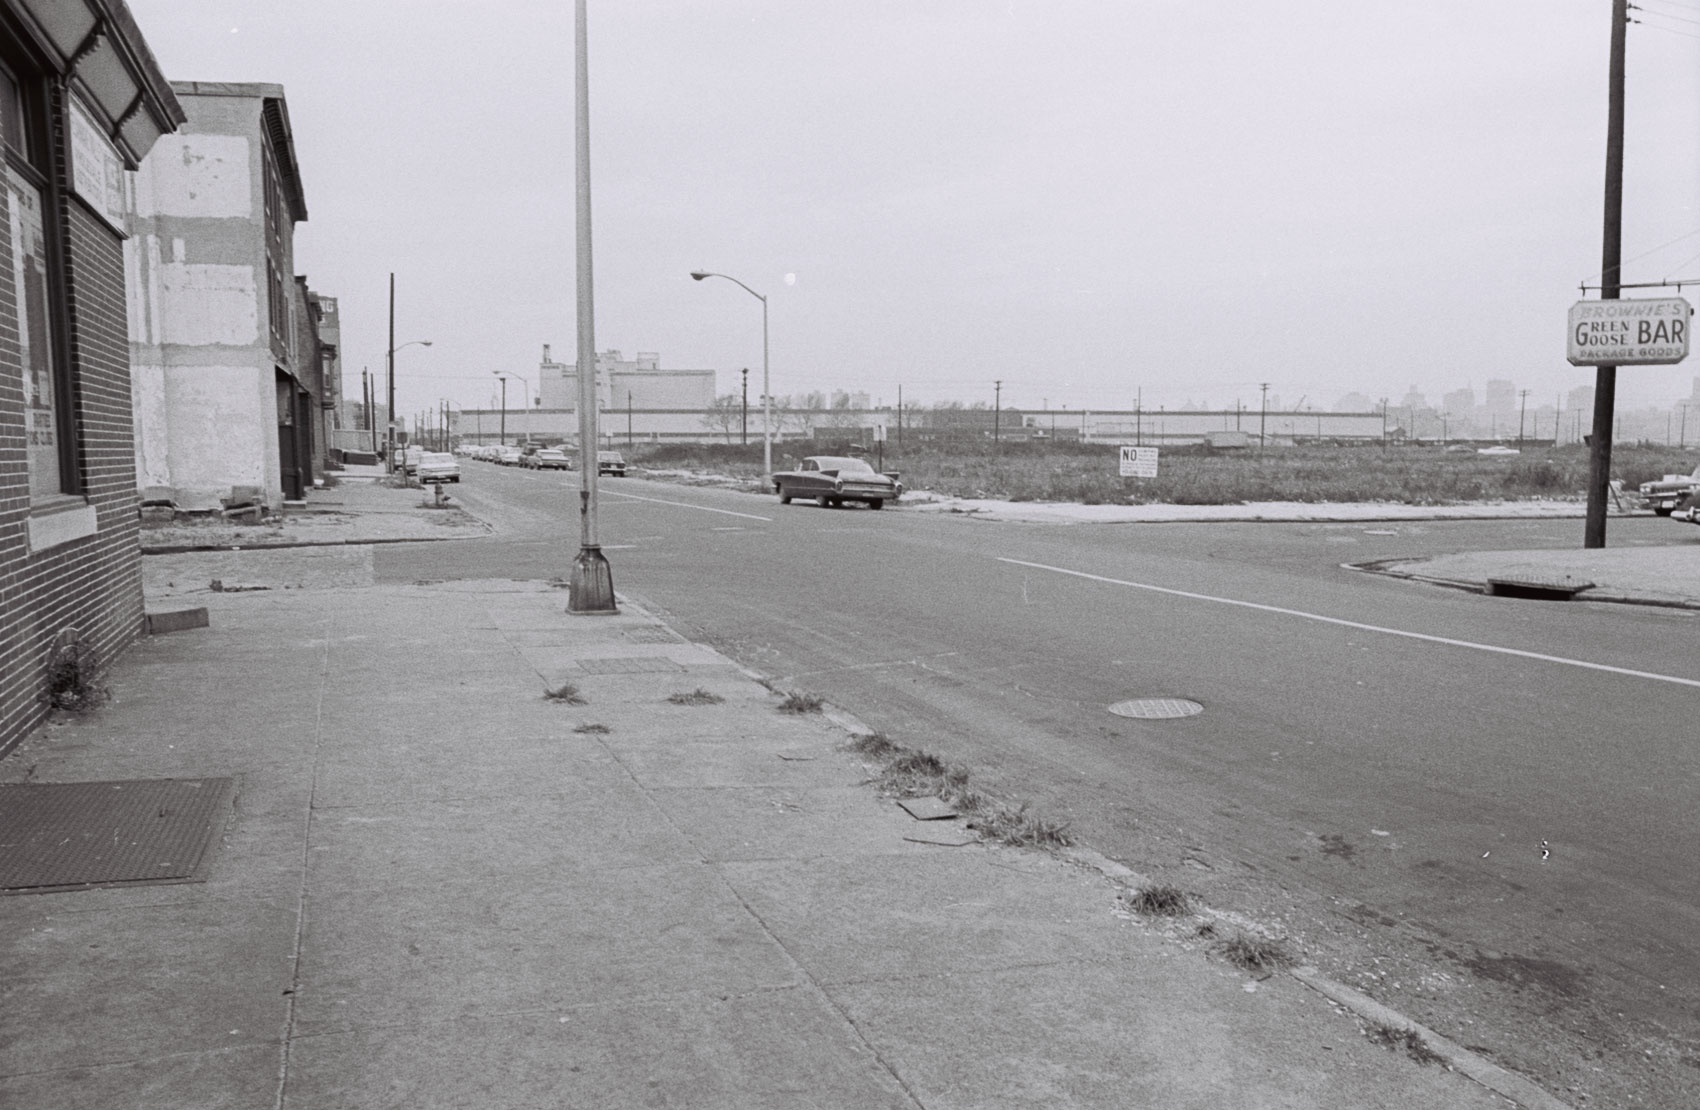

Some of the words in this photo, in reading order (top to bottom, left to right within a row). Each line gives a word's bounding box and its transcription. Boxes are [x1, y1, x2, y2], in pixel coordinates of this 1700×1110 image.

[1579, 303, 1681, 319] BROWNIE'S
[1638, 319, 1684, 345] BAR
[1580, 348, 1634, 358] PACKAGE
[1639, 347, 1681, 356] GOODS
[1123, 449, 1137, 461] NO
